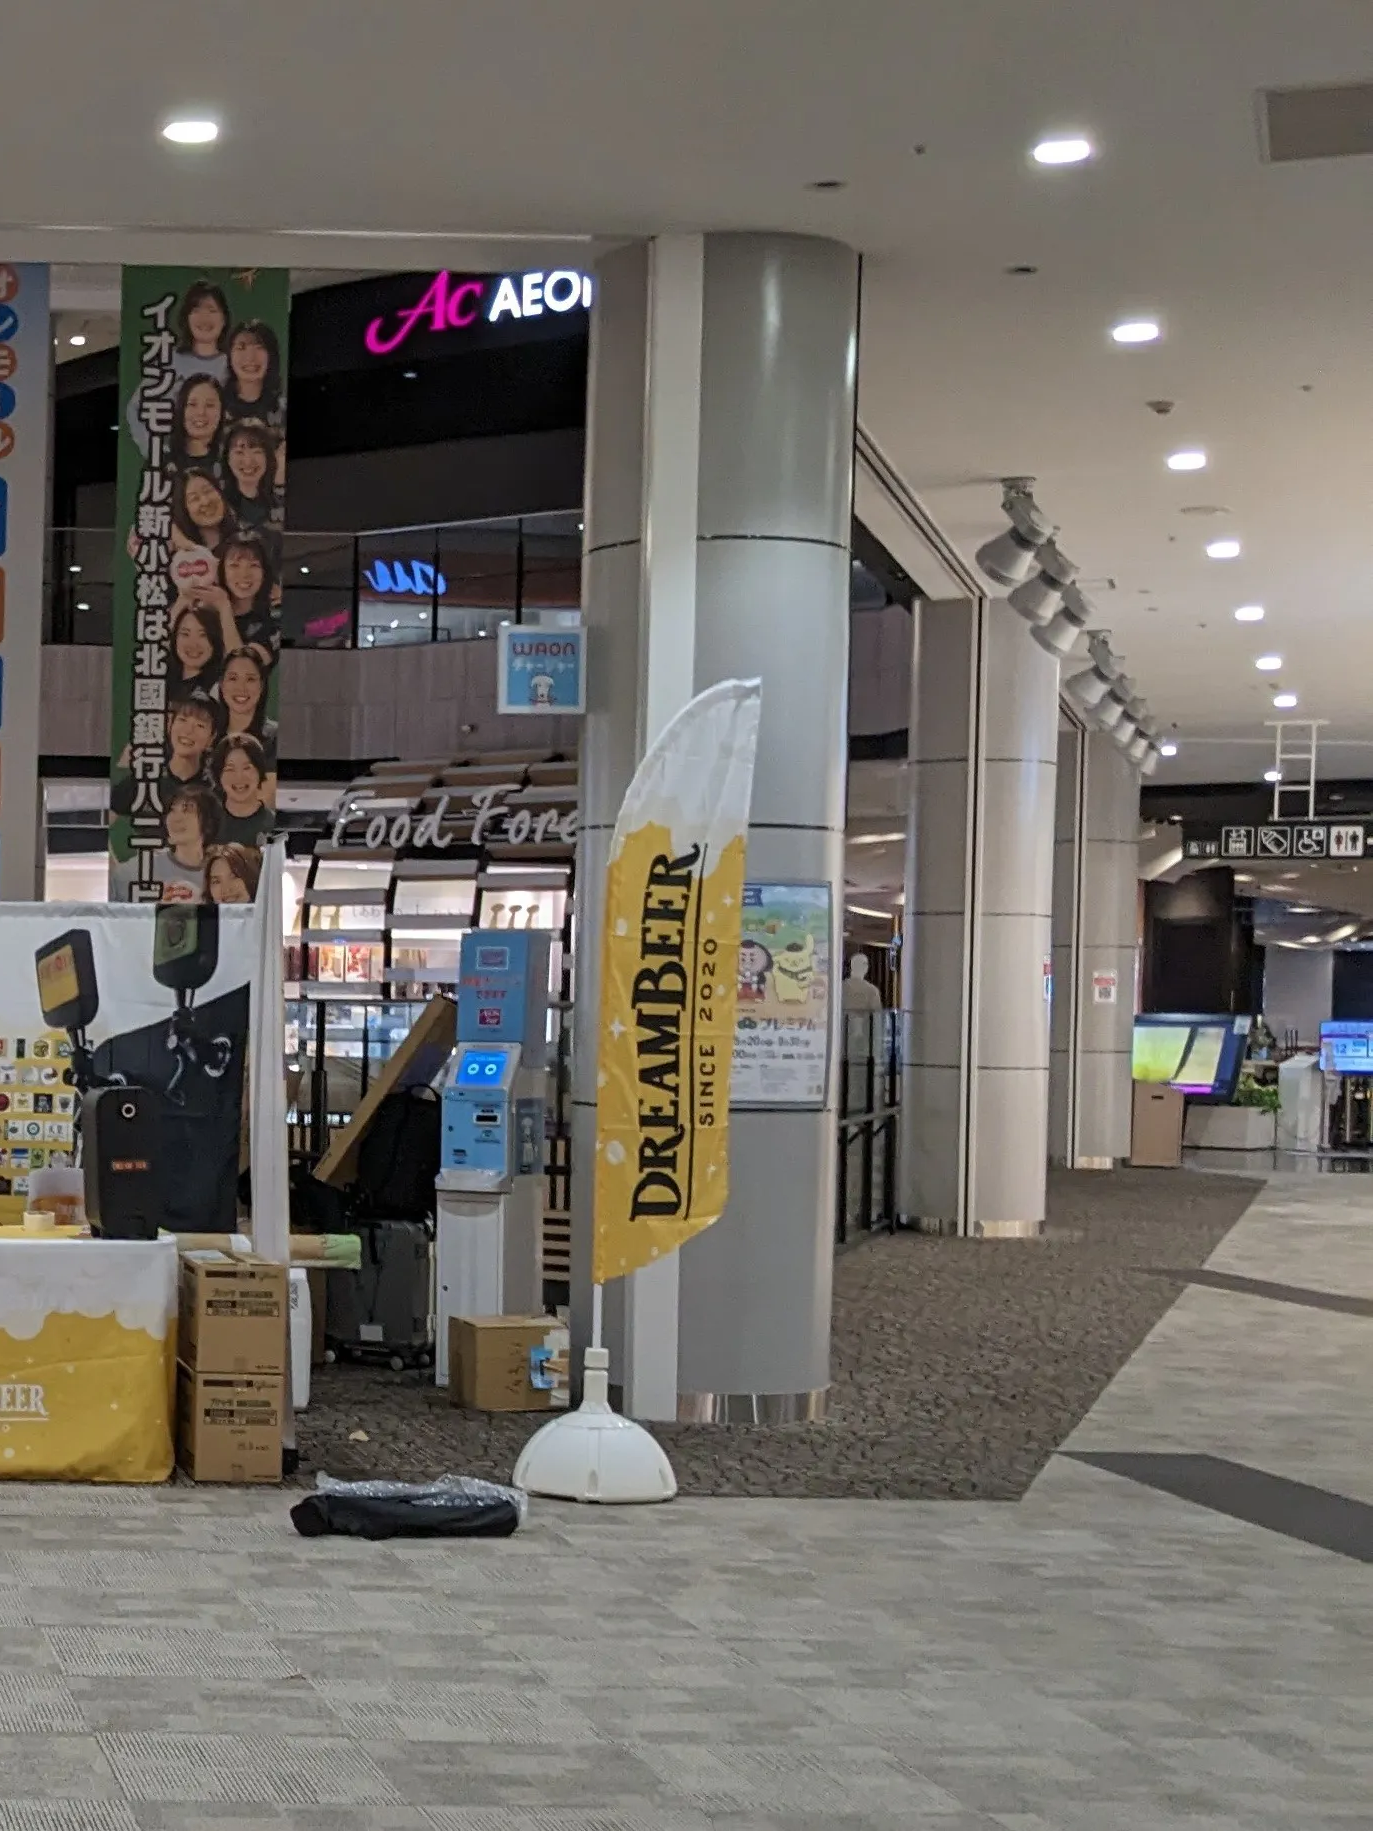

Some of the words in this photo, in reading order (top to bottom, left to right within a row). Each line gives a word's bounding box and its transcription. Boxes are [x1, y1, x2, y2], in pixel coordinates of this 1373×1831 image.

[331, 789, 454, 849] Food
[700, 938, 718, 1022] 2020
[699, 1043, 716, 1128] SINCE
